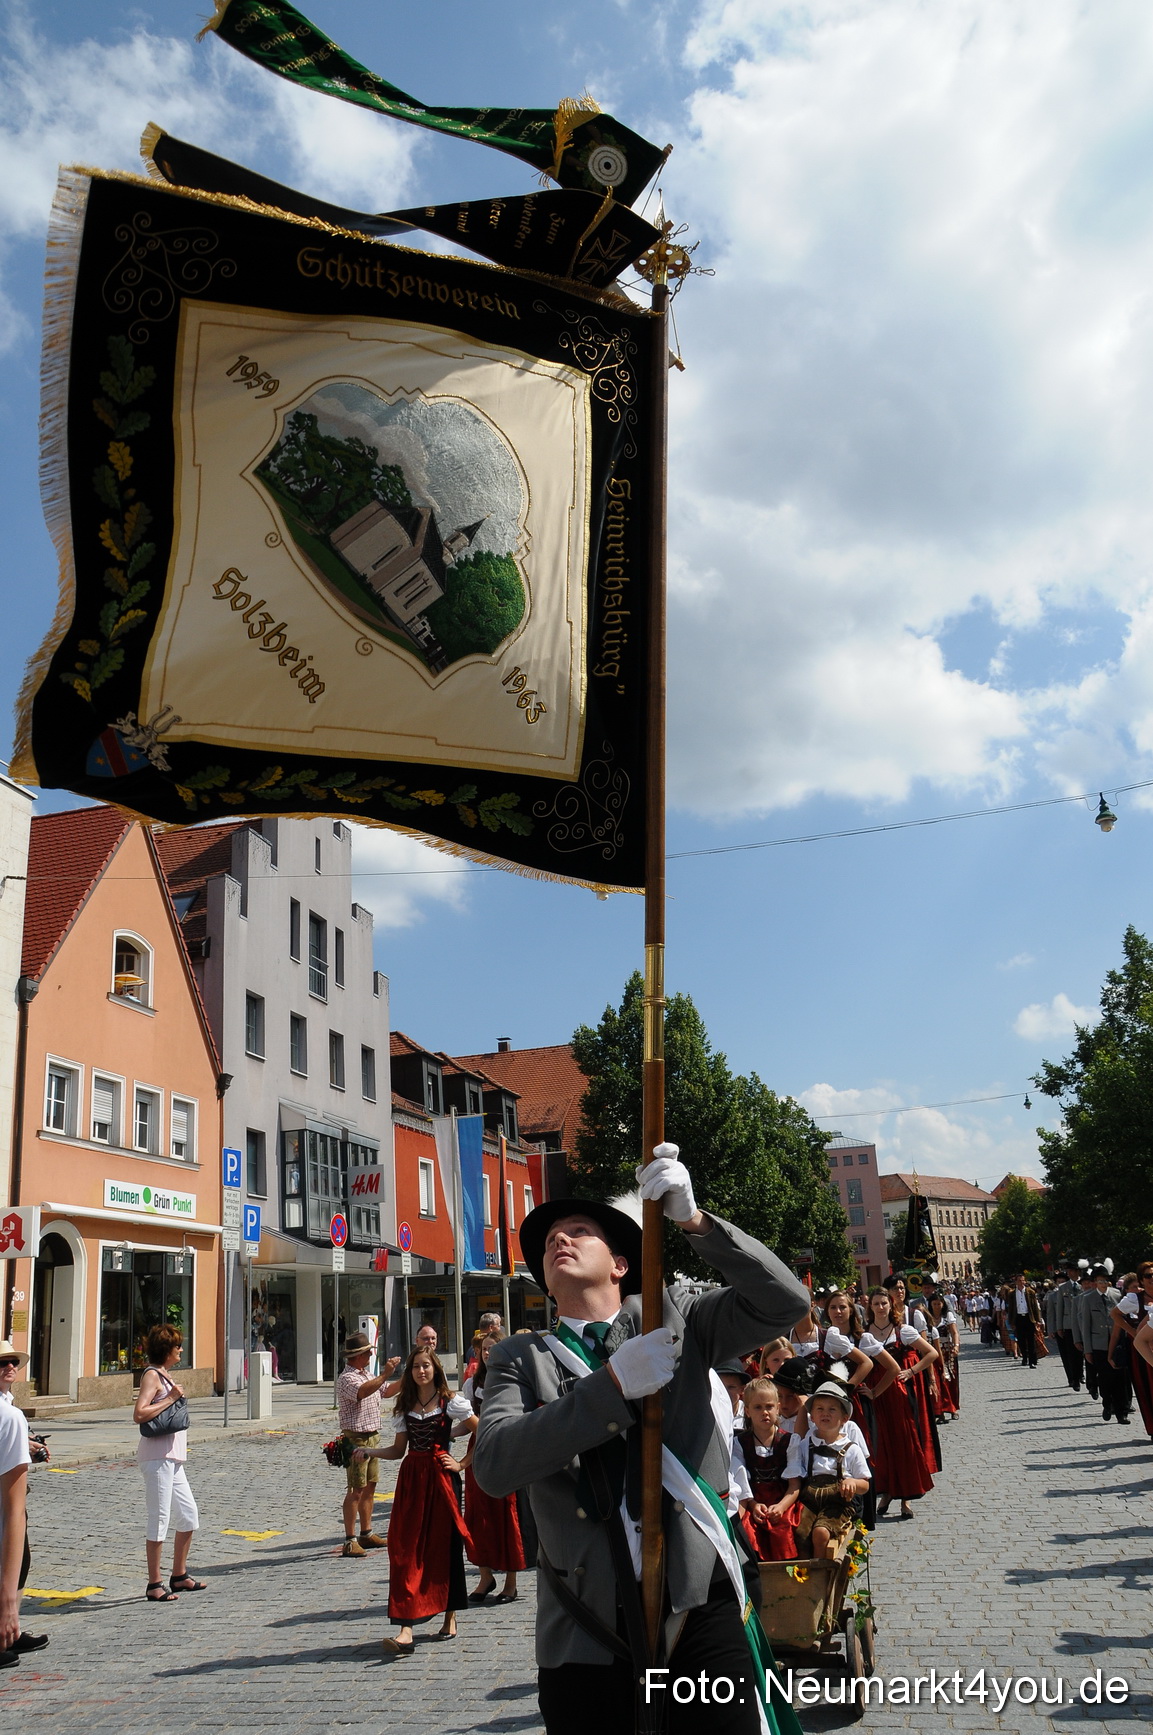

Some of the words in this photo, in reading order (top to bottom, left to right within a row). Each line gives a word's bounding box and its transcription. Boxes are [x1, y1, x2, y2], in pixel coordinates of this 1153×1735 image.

[546, 212, 566, 245] Zum
[296, 245, 522, 320] Schützenverein
[226, 355, 280, 399] 1959
[212, 567, 326, 704] Holzheim
[501, 666, 548, 724] 1963
[227, 1153, 238, 1182] P
[110, 1186, 140, 1205] Blumen
[153, 1193, 171, 1210] Grün
[172, 1196, 192, 1213] Punkt
[351, 1172, 381, 1196] H&M
[247, 1208, 257, 1237] P
[14, 1290, 25, 1302] 39
